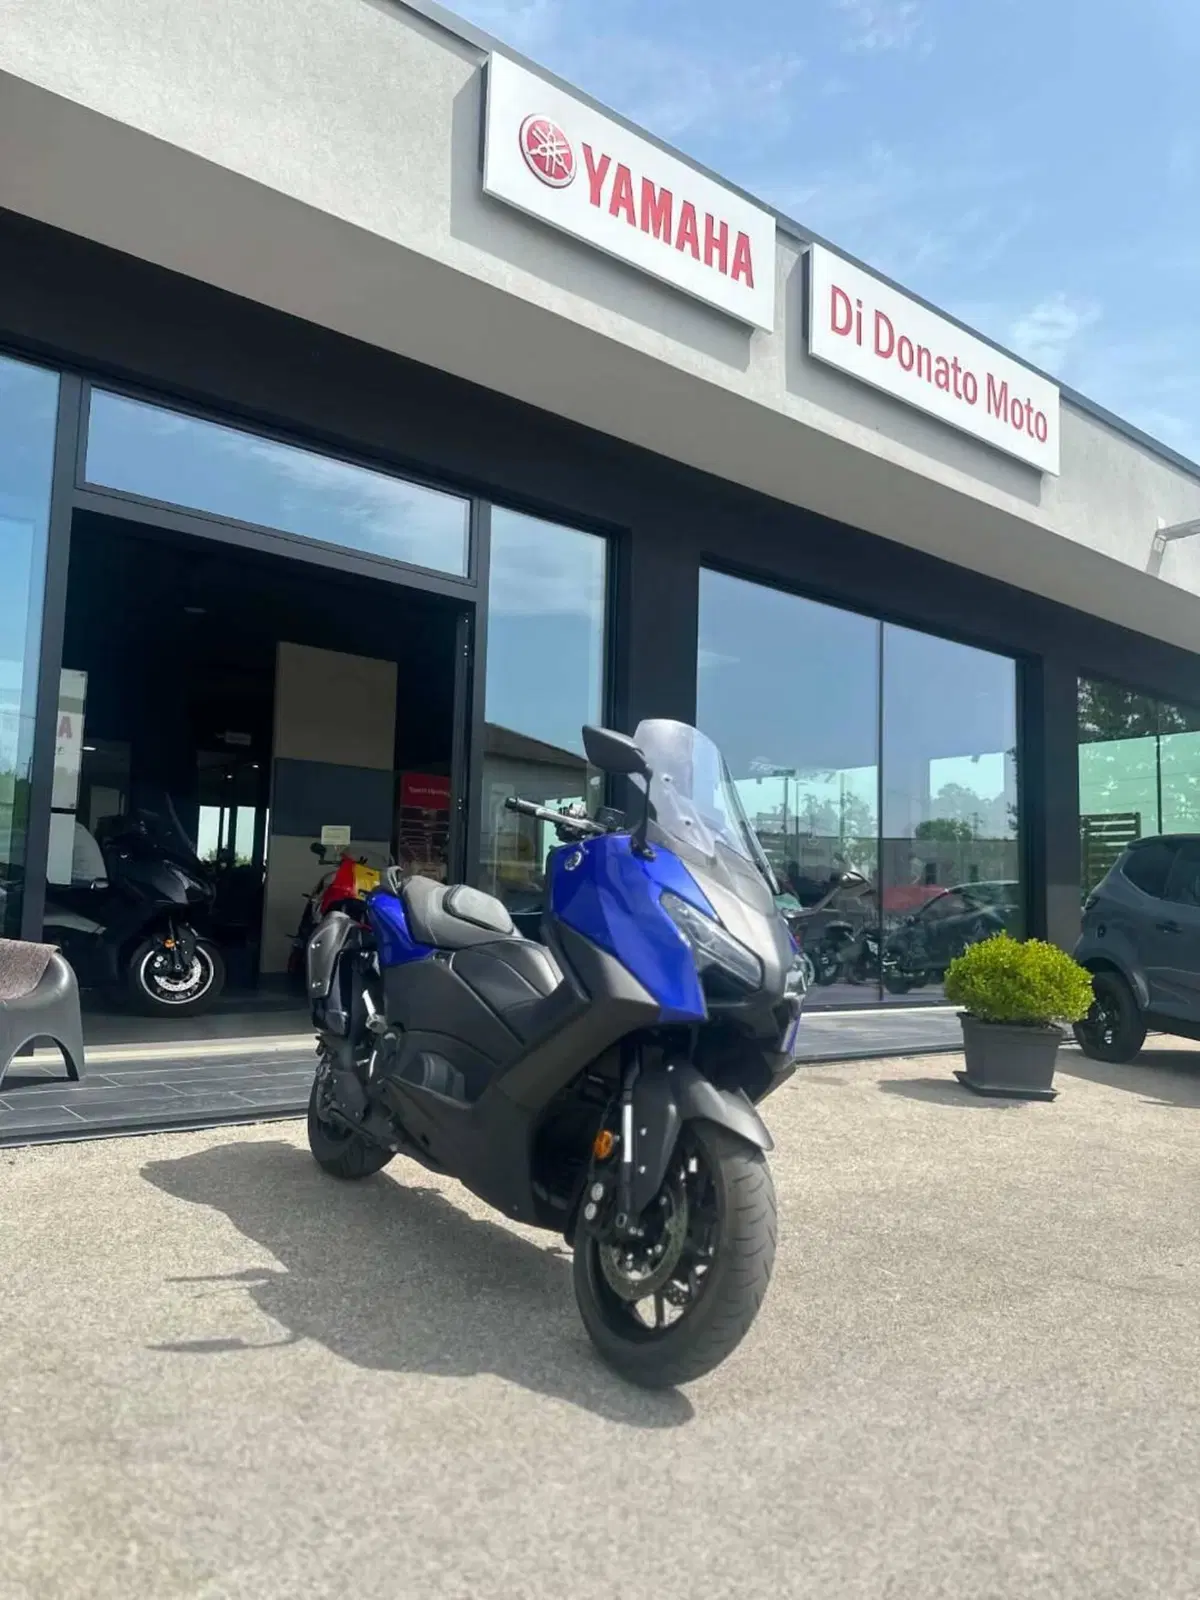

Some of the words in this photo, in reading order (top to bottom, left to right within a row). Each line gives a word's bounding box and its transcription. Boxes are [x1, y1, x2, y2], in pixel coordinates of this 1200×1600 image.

[581, 142, 755, 289] YAMAHA
[830, 284, 863, 346] Di
[873, 310, 978, 405] Donato
[986, 372, 1049, 443] Moto
